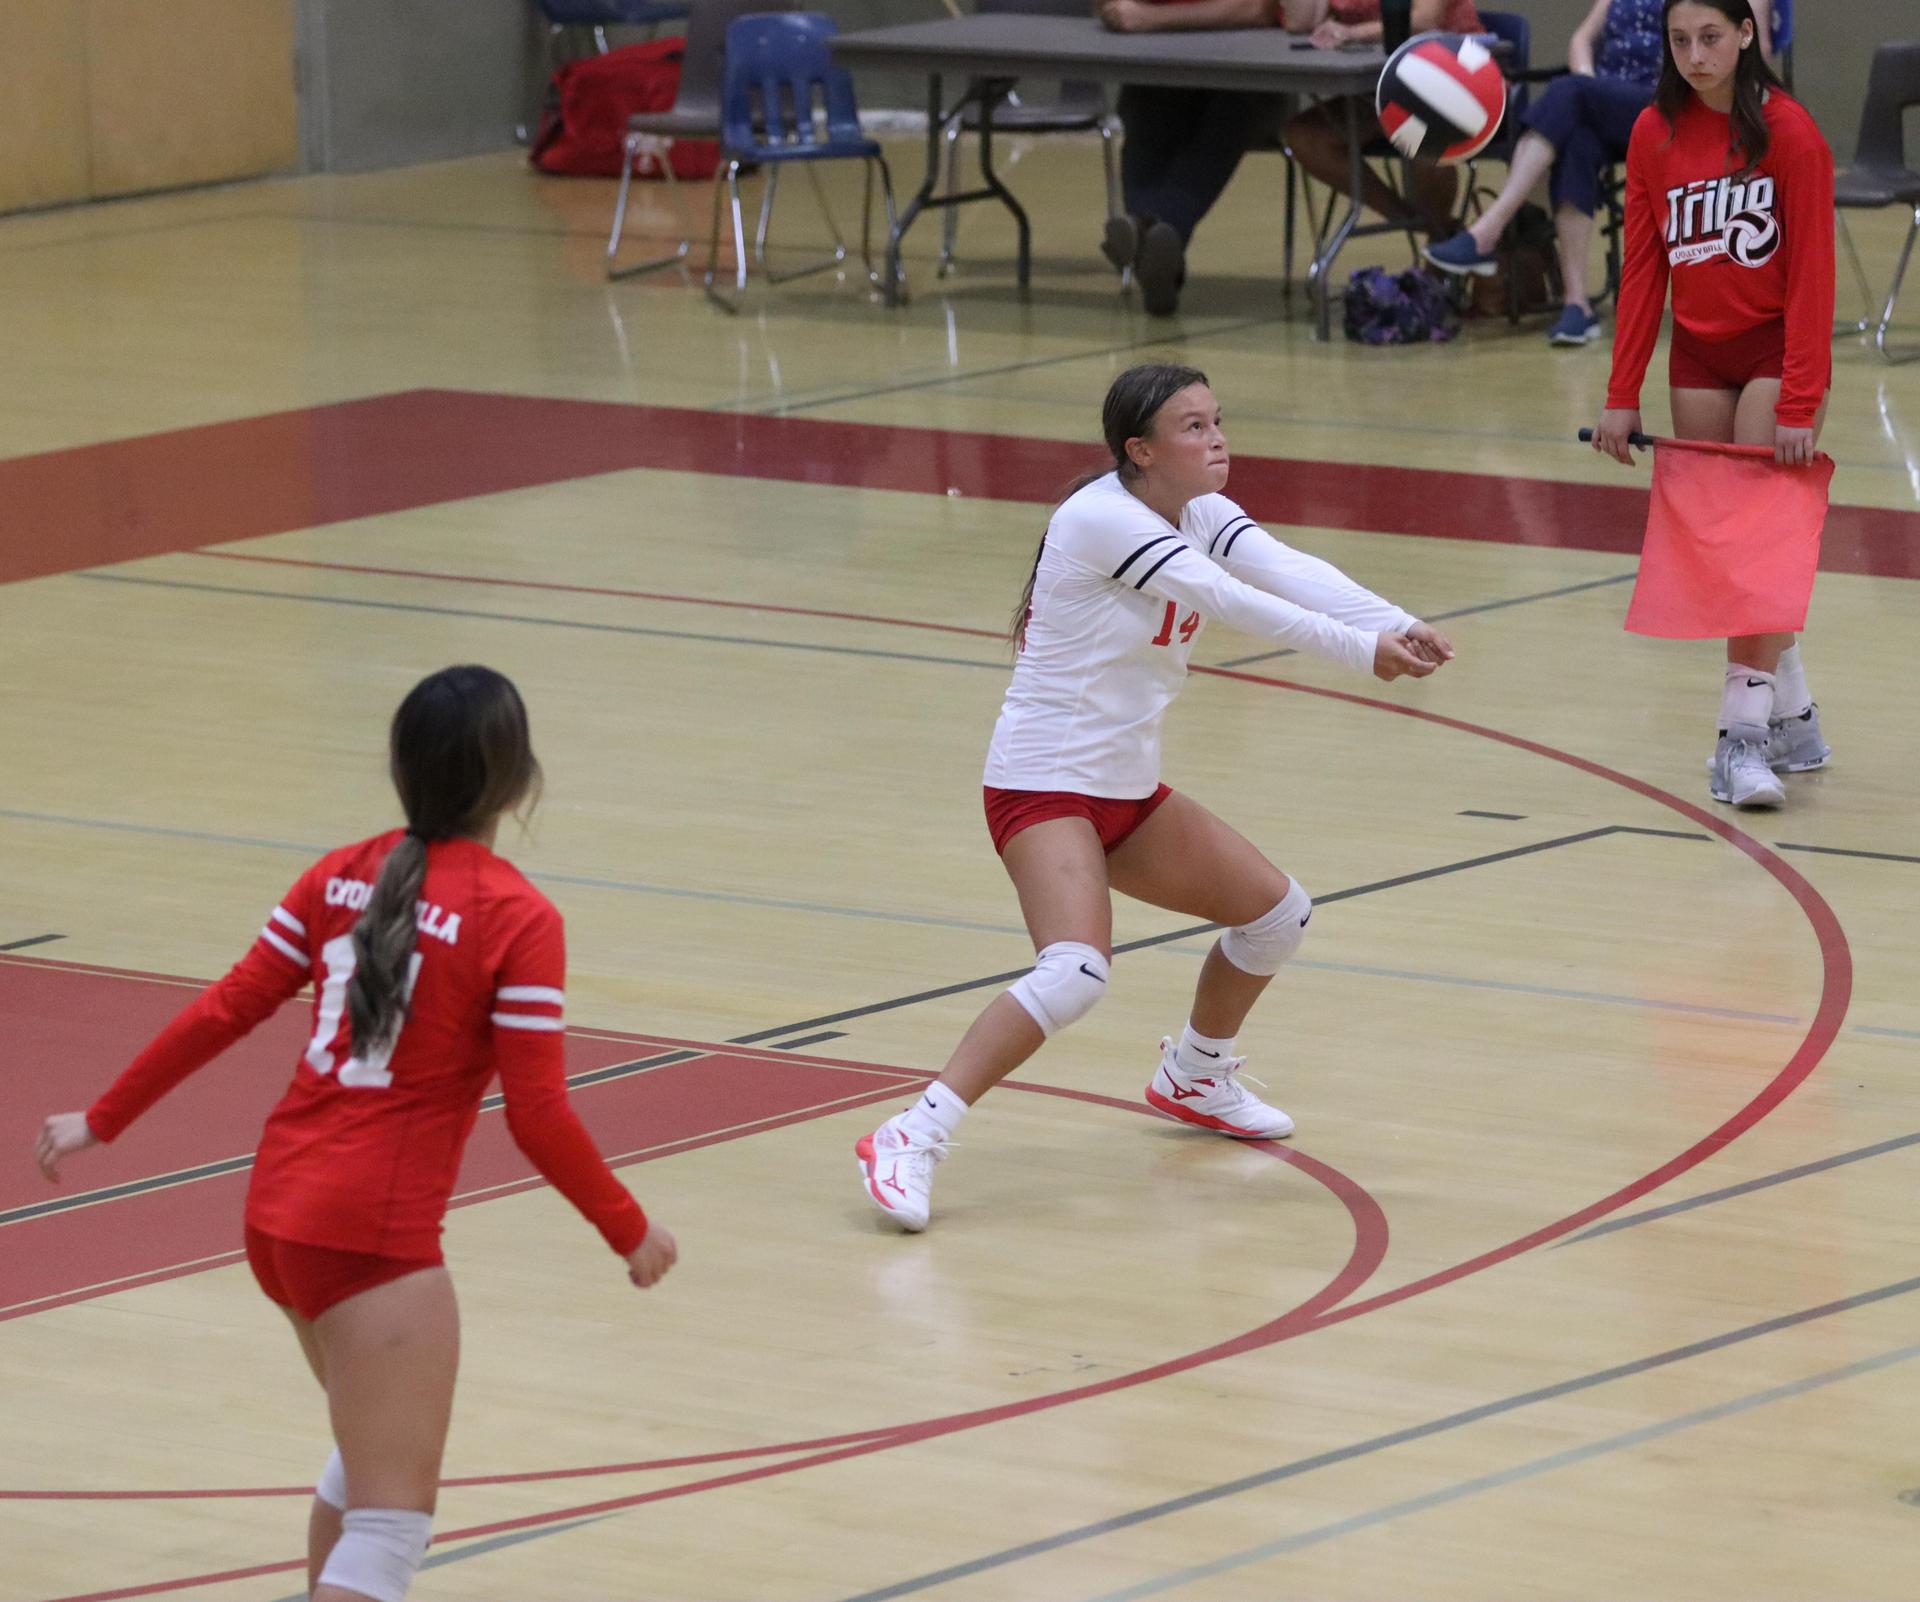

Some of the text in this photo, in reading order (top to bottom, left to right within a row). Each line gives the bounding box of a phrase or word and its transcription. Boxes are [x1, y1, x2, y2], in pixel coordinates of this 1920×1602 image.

[1666, 175, 1775, 244] Tribe
[1674, 243, 1723, 260] VOLLEYBALL
[1151, 600, 1200, 647] 14
